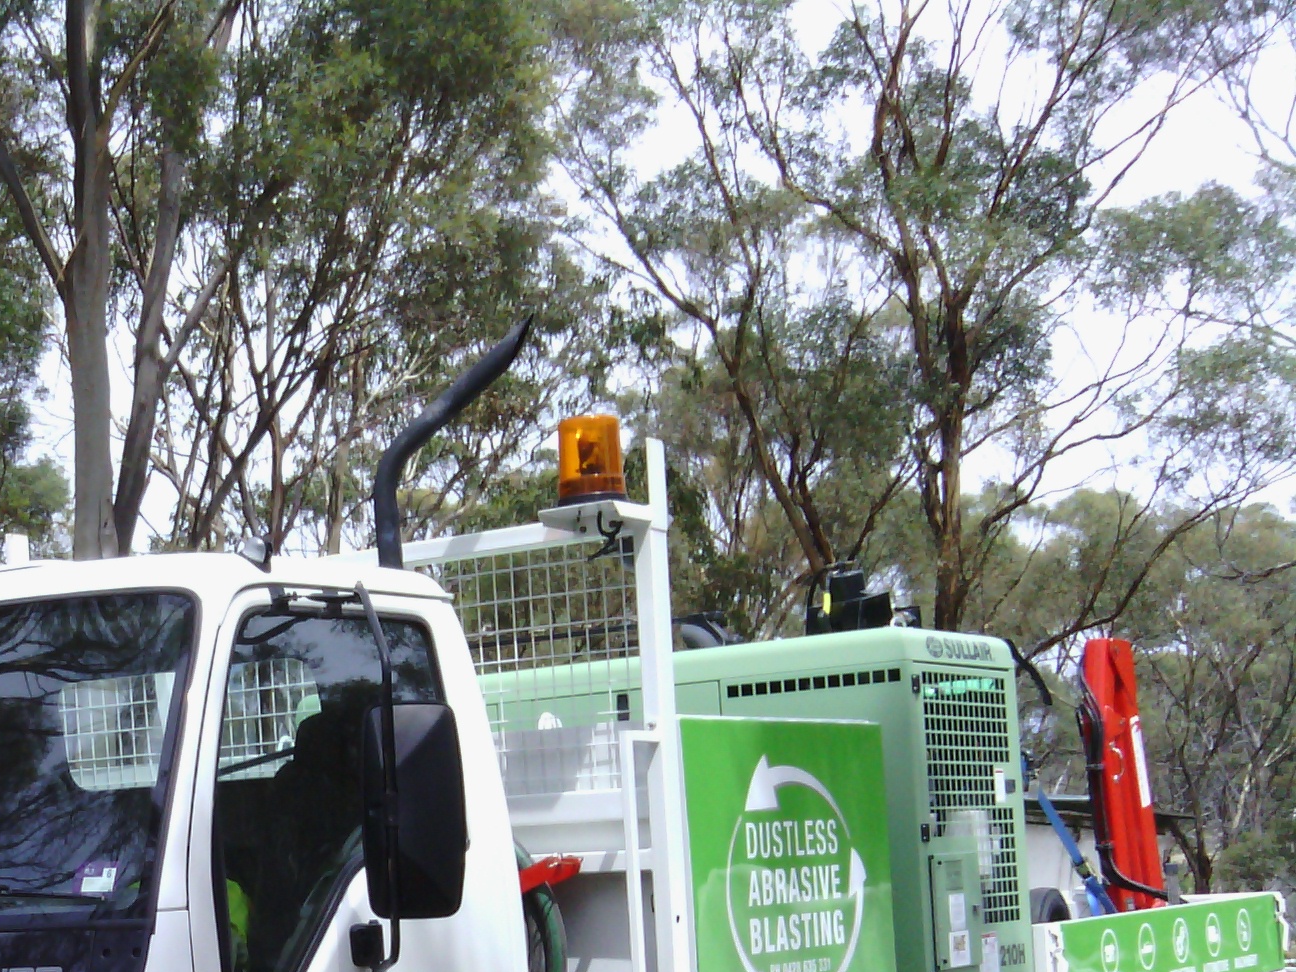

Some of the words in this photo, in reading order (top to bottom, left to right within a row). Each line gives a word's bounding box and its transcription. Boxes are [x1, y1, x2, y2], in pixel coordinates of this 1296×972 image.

[943, 637, 993, 661] SULLAIR
[745, 818, 838, 859] DUSTLESS
[748, 863, 842, 907] ABRASIVE
[749, 908, 845, 955] BLASTING
[999, 943, 1026, 967] 210H
